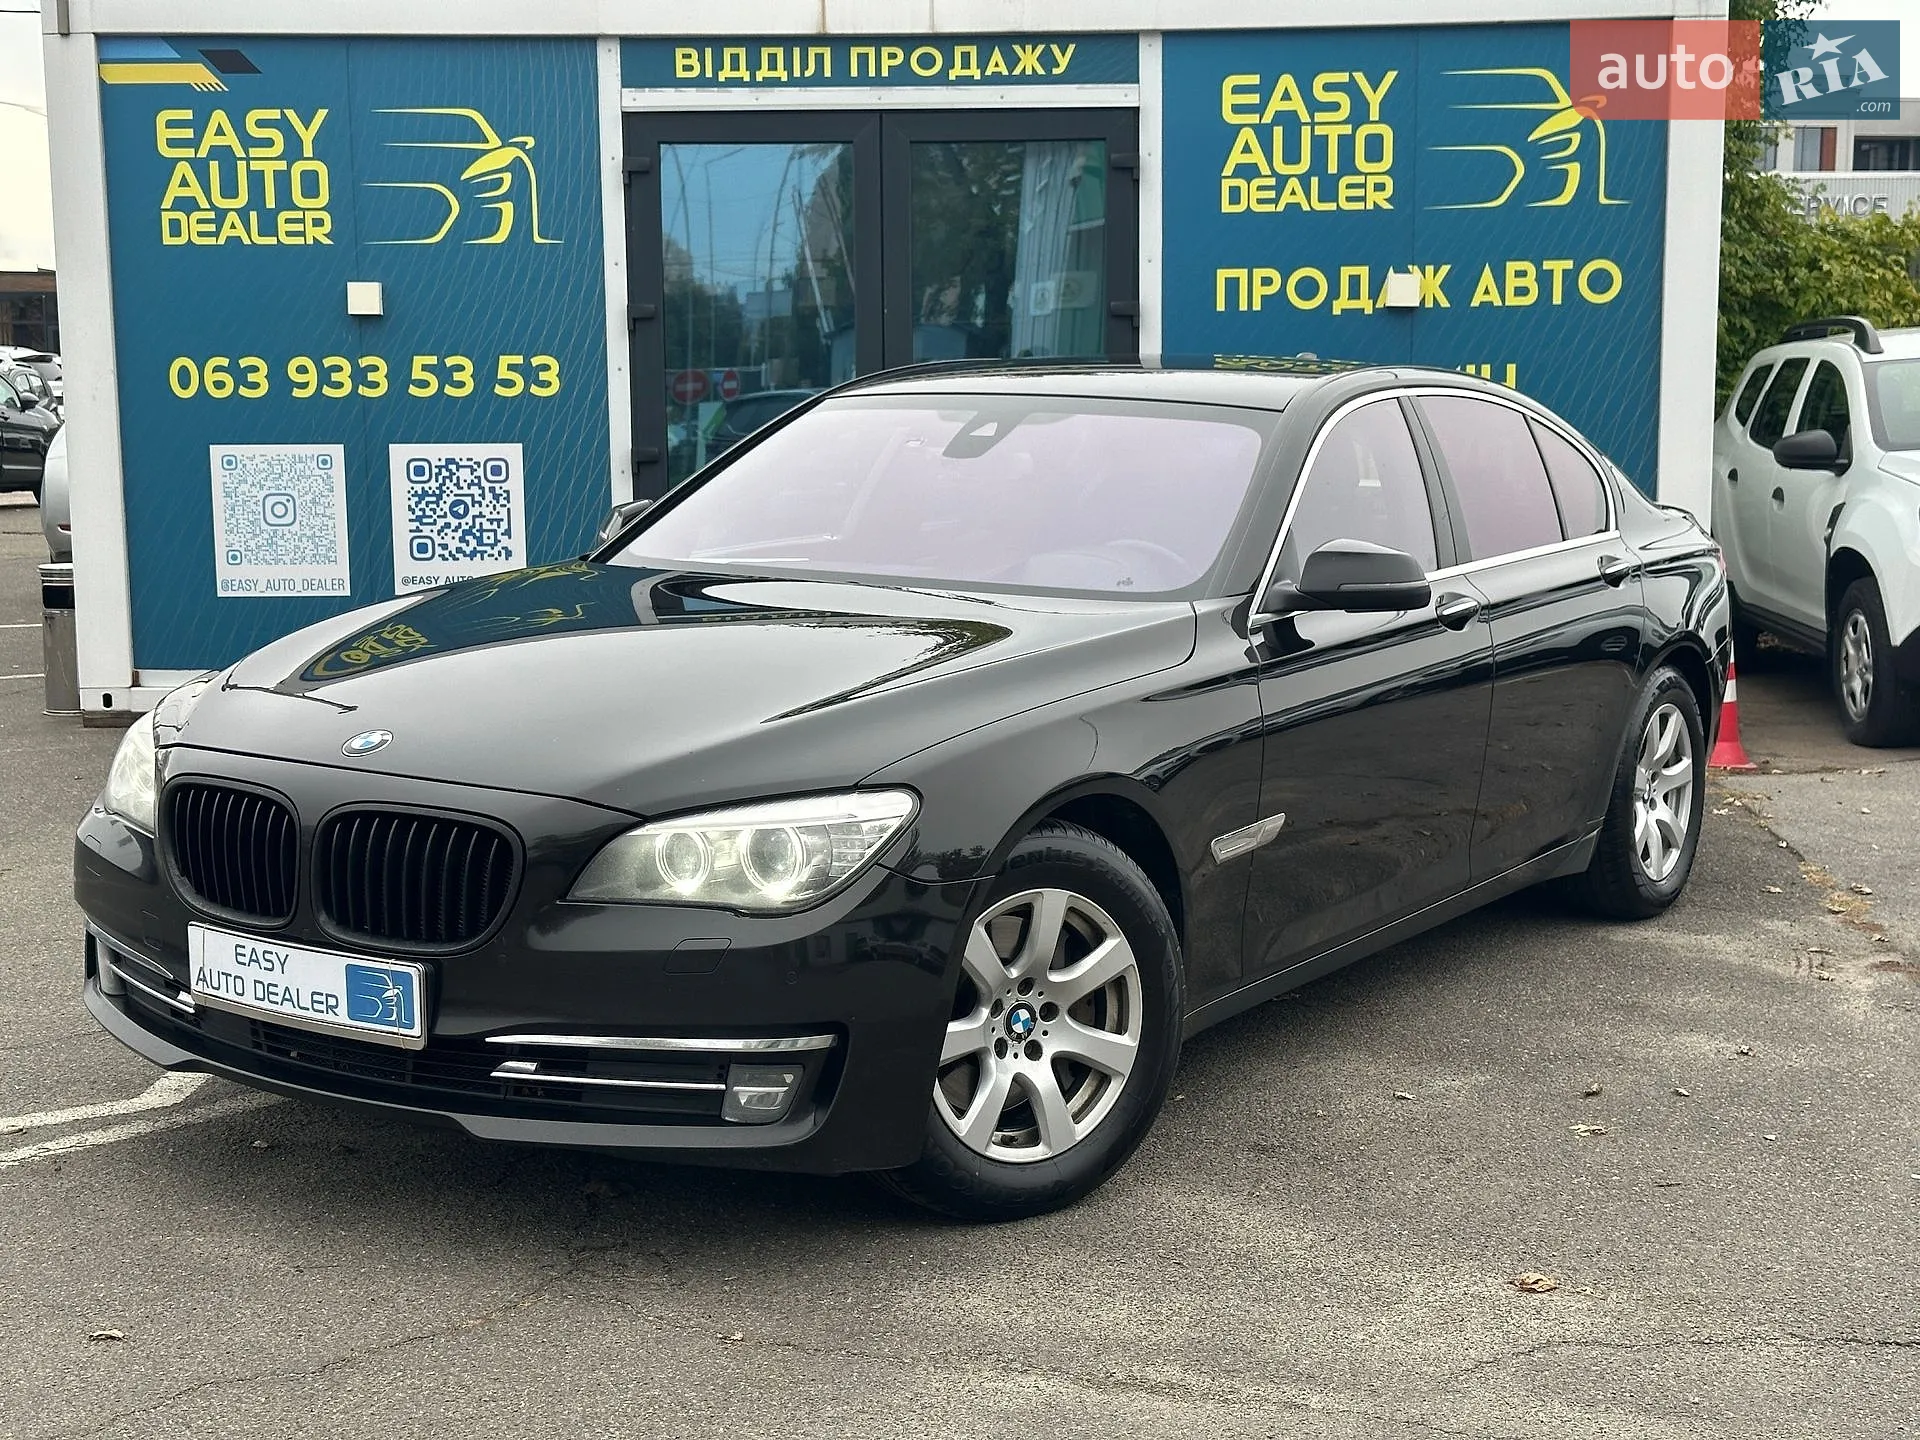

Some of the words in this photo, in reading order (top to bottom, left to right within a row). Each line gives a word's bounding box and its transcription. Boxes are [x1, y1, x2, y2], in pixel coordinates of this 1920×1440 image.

[674, 46, 832, 82] ВІДДІЛ
[849, 43, 1077, 81] ПРОДАЖУ
[1221, 70, 1399, 125] EASY
[155, 108, 329, 158] EASY
[1221, 123, 1394, 177] AUTO
[160, 160, 330, 209] AUTO
[1221, 174, 1394, 213] DEALER
[1781, 193, 1889, 217] ERVICE
[161, 210, 334, 245] DEALER
[1470, 258, 1623, 308] АВТО
[168, 355, 270, 399] 063
[286, 355, 390, 399] 933
[407, 354, 475, 398] 53
[493, 354, 562, 398] 53
[220, 577, 346, 593] @EASY_AUTO_DEALER
[234, 943, 290, 975] EASY
[195, 965, 246, 997] AUTO
[253, 978, 340, 1017] DEALER
